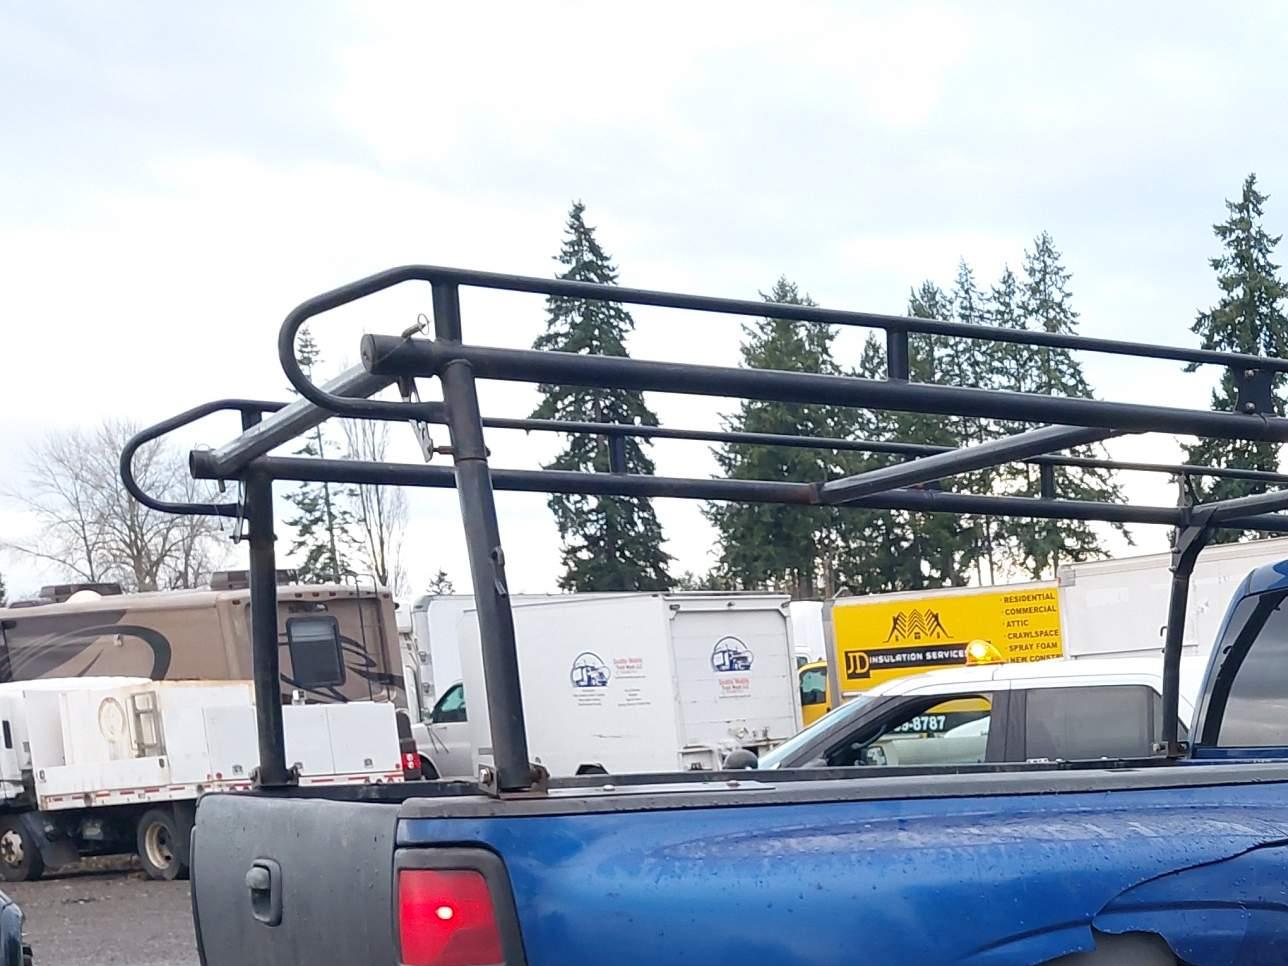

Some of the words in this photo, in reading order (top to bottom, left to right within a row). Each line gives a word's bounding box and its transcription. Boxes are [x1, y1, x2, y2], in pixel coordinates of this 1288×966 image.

[1003, 592, 1056, 603] RESIDENTIAL
[1004, 605, 1057, 615] COMMERCIAL
[1006, 619, 1029, 628] ATTIC
[1007, 629, 1059, 639] CRAWLSPACE
[1008, 643, 1034, 652] SPRAY
[1036, 642, 1058, 650] FOAM
[847, 651, 869, 674] JD
[869, 652, 923, 664] INSULATION
